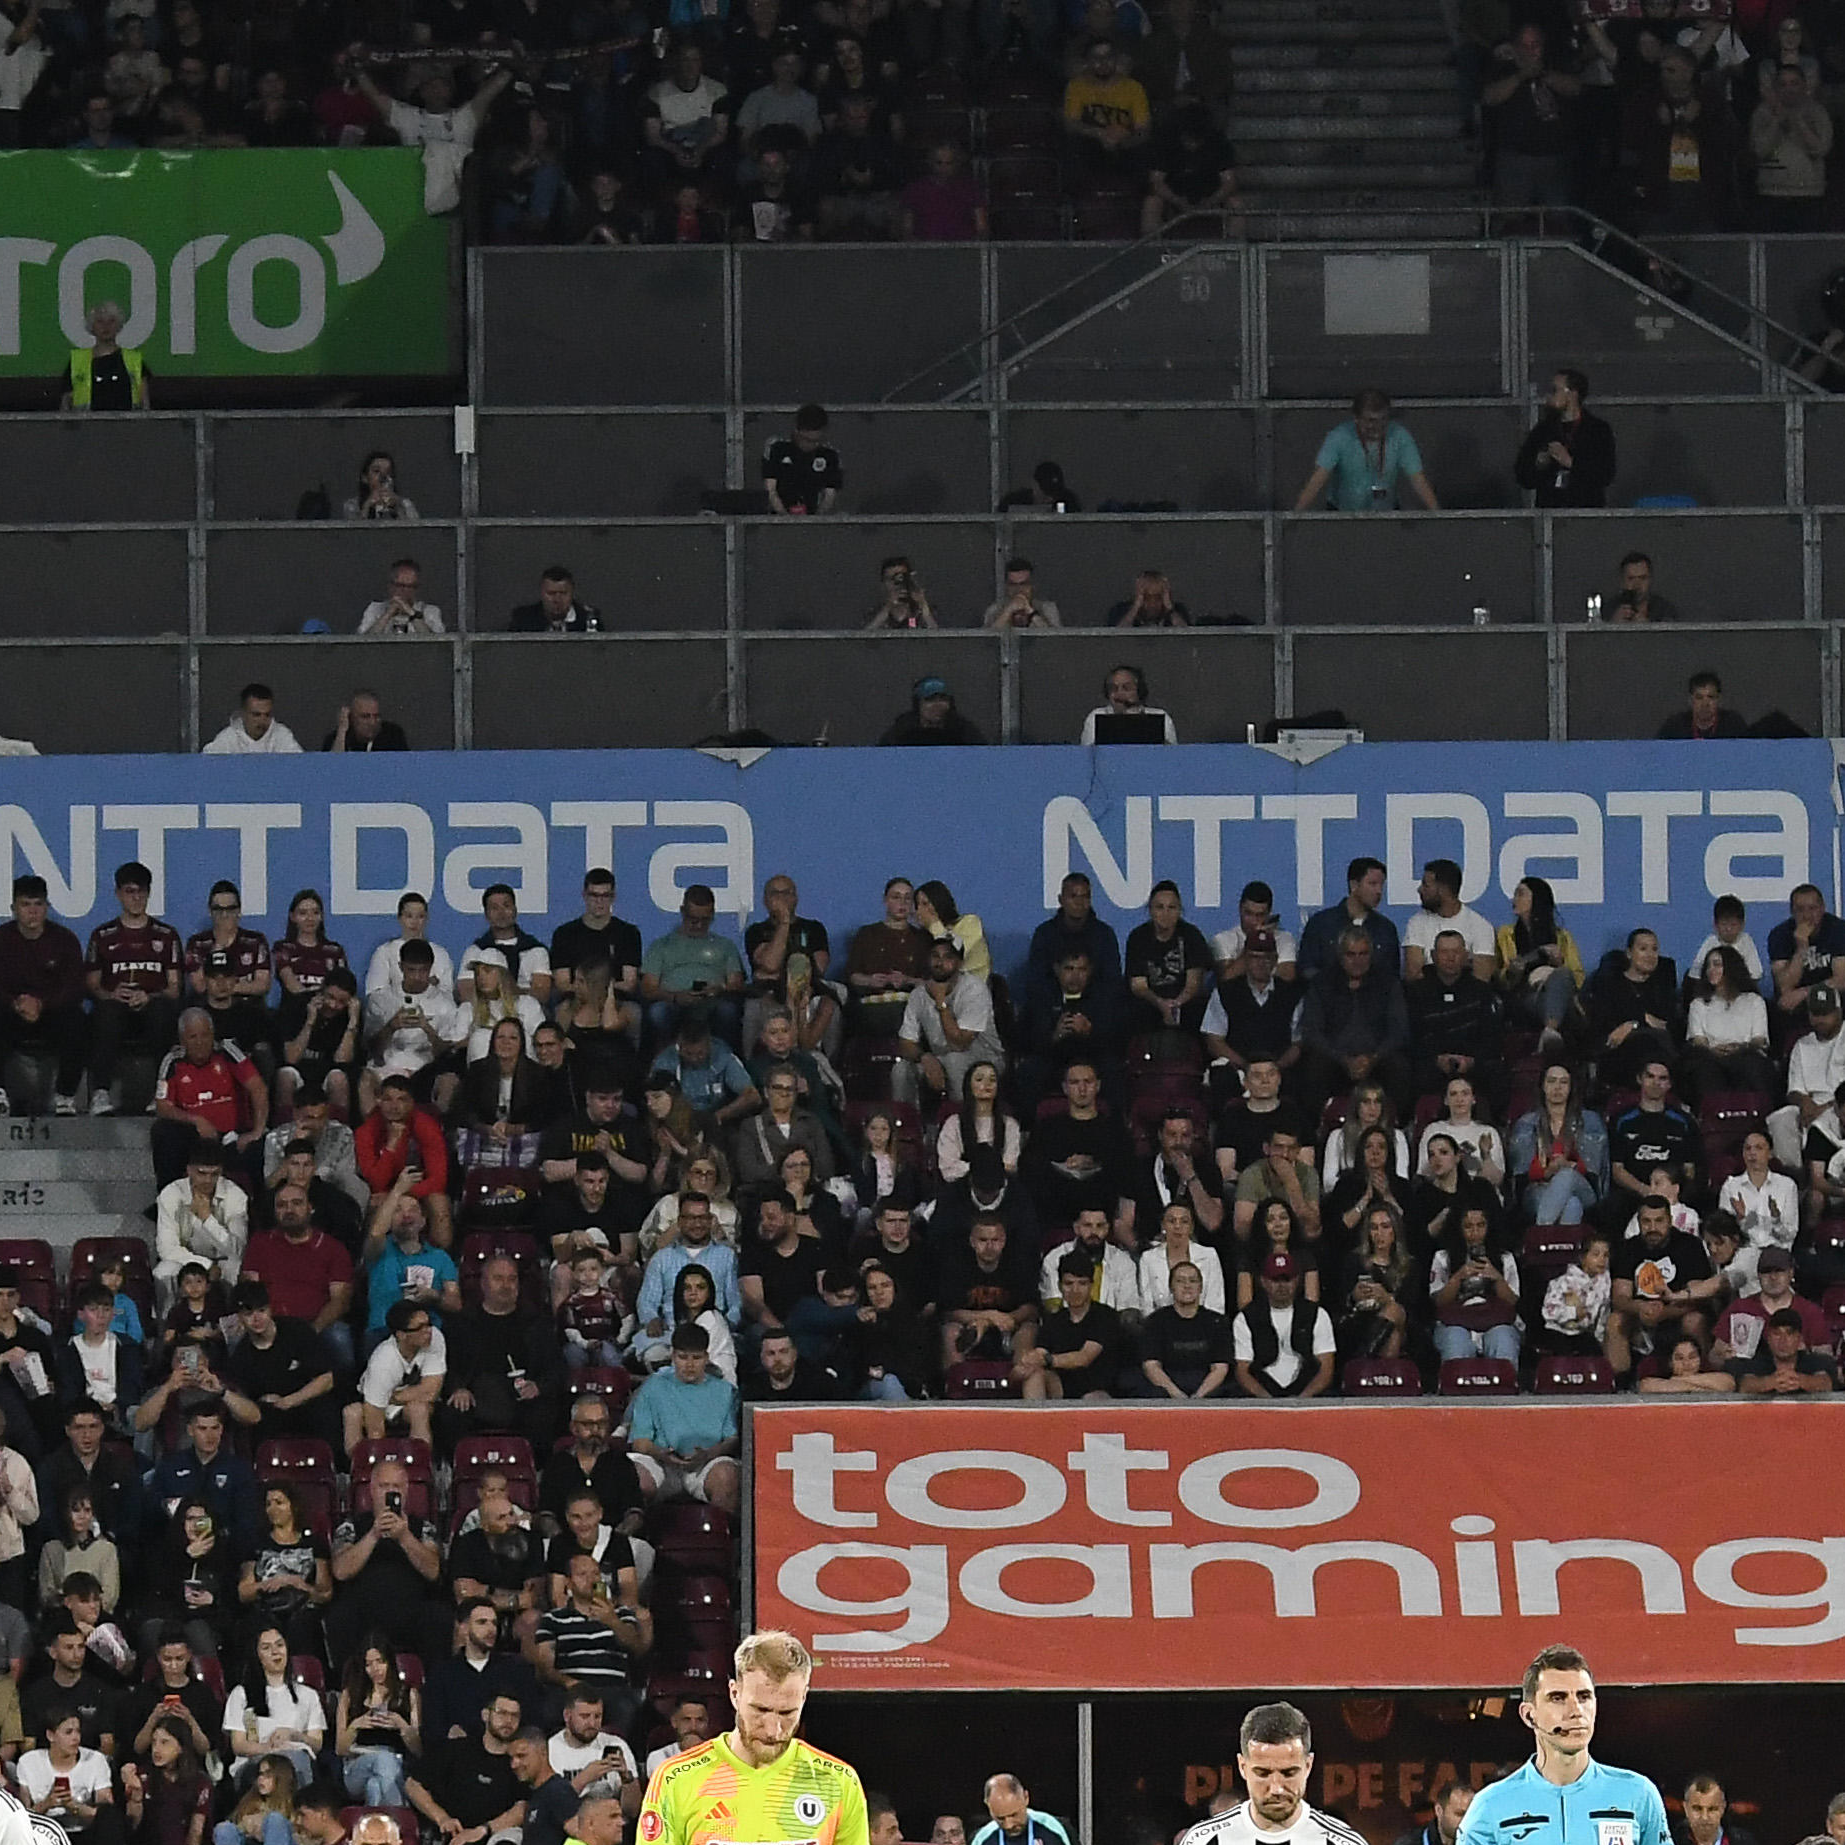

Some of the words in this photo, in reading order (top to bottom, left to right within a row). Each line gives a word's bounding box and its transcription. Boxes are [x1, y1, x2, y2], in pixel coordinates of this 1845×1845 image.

[1042, 793, 1360, 909] NTT
[775, 1431, 1362, 1531] toto
[801, 1800, 817, 1818] U
[1323, 1763, 1384, 1808] DE
